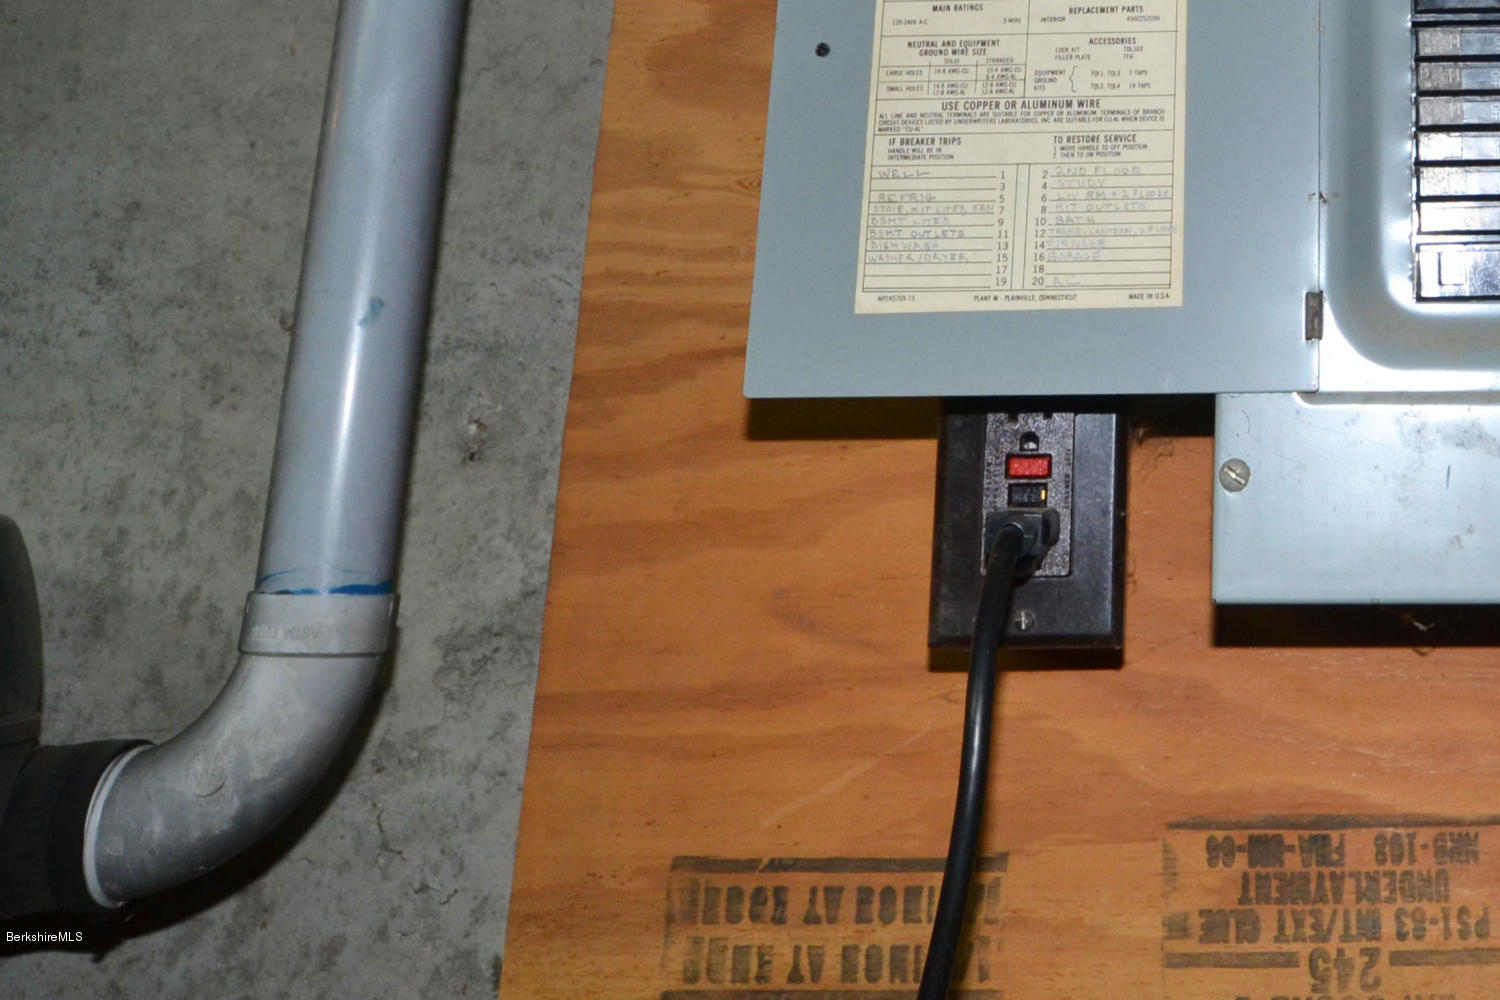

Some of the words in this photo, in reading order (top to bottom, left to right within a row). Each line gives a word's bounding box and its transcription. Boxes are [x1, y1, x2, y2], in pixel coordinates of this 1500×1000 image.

[932, 4, 950, 12] MAIN
[1069, 6, 1118, 14] REPLACEMENT
[959, 40, 1000, 48] EQUIPMENT
[1089, 37, 1136, 45] ACCESSORIES
[952, 48, 968, 56] WIRE
[942, 101, 961, 111] USE
[964, 101, 1000, 110] COPPER
[1005, 101, 1017, 109] OR
[1021, 100, 1073, 109] ALUMINUM
[1077, 99, 1100, 108] WIRE
[889, 138, 896, 146] IF
[900, 138, 936, 146] BREAKER
[939, 137, 962, 145] TRIPS
[1054, 135, 1063, 143] TO
[1067, 135, 1100, 143] RESTORE
[1104, 134, 1136, 142] SERVICE
[879, 169, 930, 178] WELL
[1001, 171, 1005, 179] 1
[1042, 170, 1048, 179] 2
[1042, 193, 1047, 201] 6
[999, 206, 1004, 215] 7
[1036, 217, 1046, 226] 10
[1035, 229, 1046, 237] 12
[998, 242, 1008, 250] 13
[1034, 241, 1045, 249] 14
[997, 254, 1008, 262] 15
[1034, 253, 1045, 261] 16
[996, 266, 1007, 274] 17
[1033, 265, 1044, 273] 18
[996, 278, 1006, 286] 19
[1032, 277, 1044, 285] 20
[1238, 871, 1450, 906] UNDERLAYMENT
[1309, 947, 1381, 992] 245
